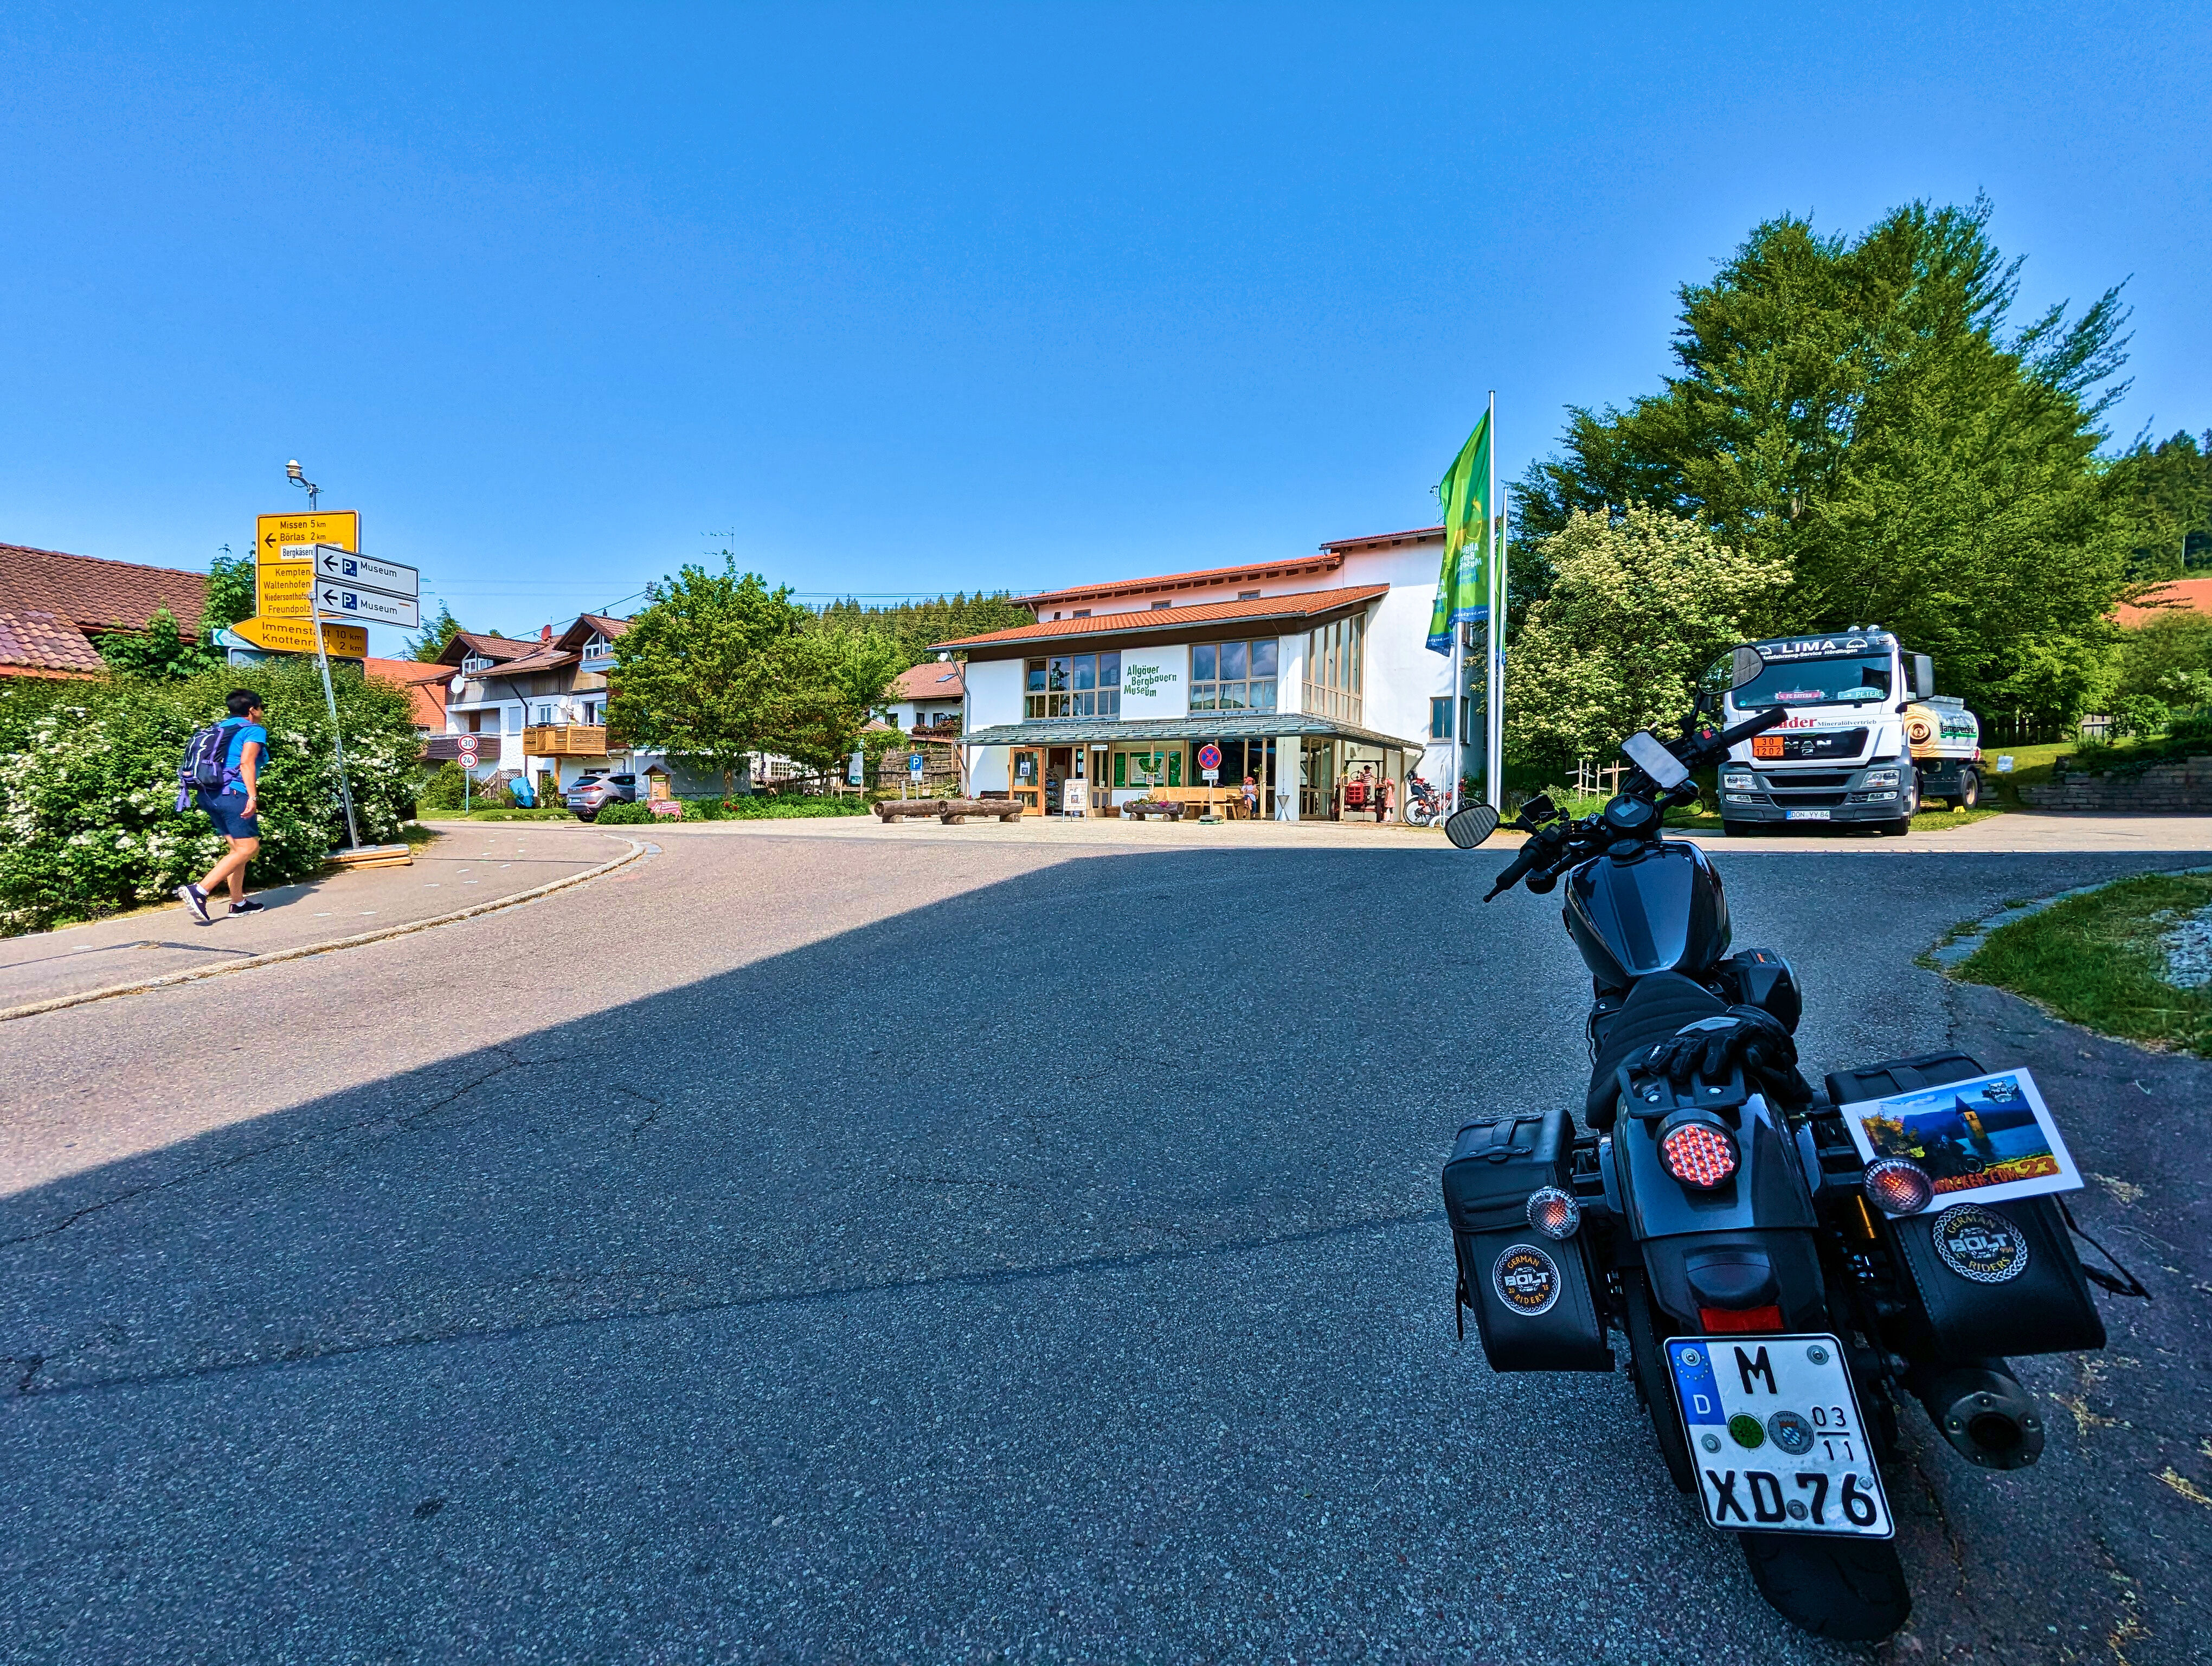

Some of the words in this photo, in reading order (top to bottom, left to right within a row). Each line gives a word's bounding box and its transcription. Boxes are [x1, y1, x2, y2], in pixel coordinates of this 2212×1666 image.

[280, 533, 305, 541] Börlas
[275, 568, 310, 578] Kempten
[344, 561, 352, 573] P
[361, 561, 397, 578] Museum
[263, 580, 311, 589] Waltenhofen
[344, 594, 352, 606] P
[361, 599, 397, 614] Museum
[268, 605, 310, 614] Freundpolz
[336, 630, 346, 639] 10
[263, 633, 329, 648] Knottenrid
[340, 642, 345, 650] 2
[1782, 640, 1836, 653] LIMA
[1127, 664, 1159, 677] Allgäuer
[1131, 674, 1176, 689] Bergbauern
[1124, 684, 1156, 697] Museum
[1770, 716, 1817, 729] ader
[1757, 747, 1782, 755] 1202
[1785, 740, 1831, 749] MAN
[913, 758, 919, 768] P
[2020, 1157, 2059, 1178] 23
[1946, 1214, 1996, 1233] GERMAN
[1948, 1233, 2007, 1252] BOLT
[1507, 1255, 1540, 1268] GERMAN
[1969, 1257, 2011, 1272] RIDERS
[1504, 1272, 1549, 1286] BOLT
[1514, 1292, 1545, 1304] RIDERS
[1733, 1345, 1778, 1394] M
[1693, 1394, 1711, 1414] D
[1811, 1406, 1847, 1427] 03
[1823, 1439, 1854, 1461] 11
[1706, 1470, 1786, 1522] XD
[1796, 1472, 1877, 1527] 76
